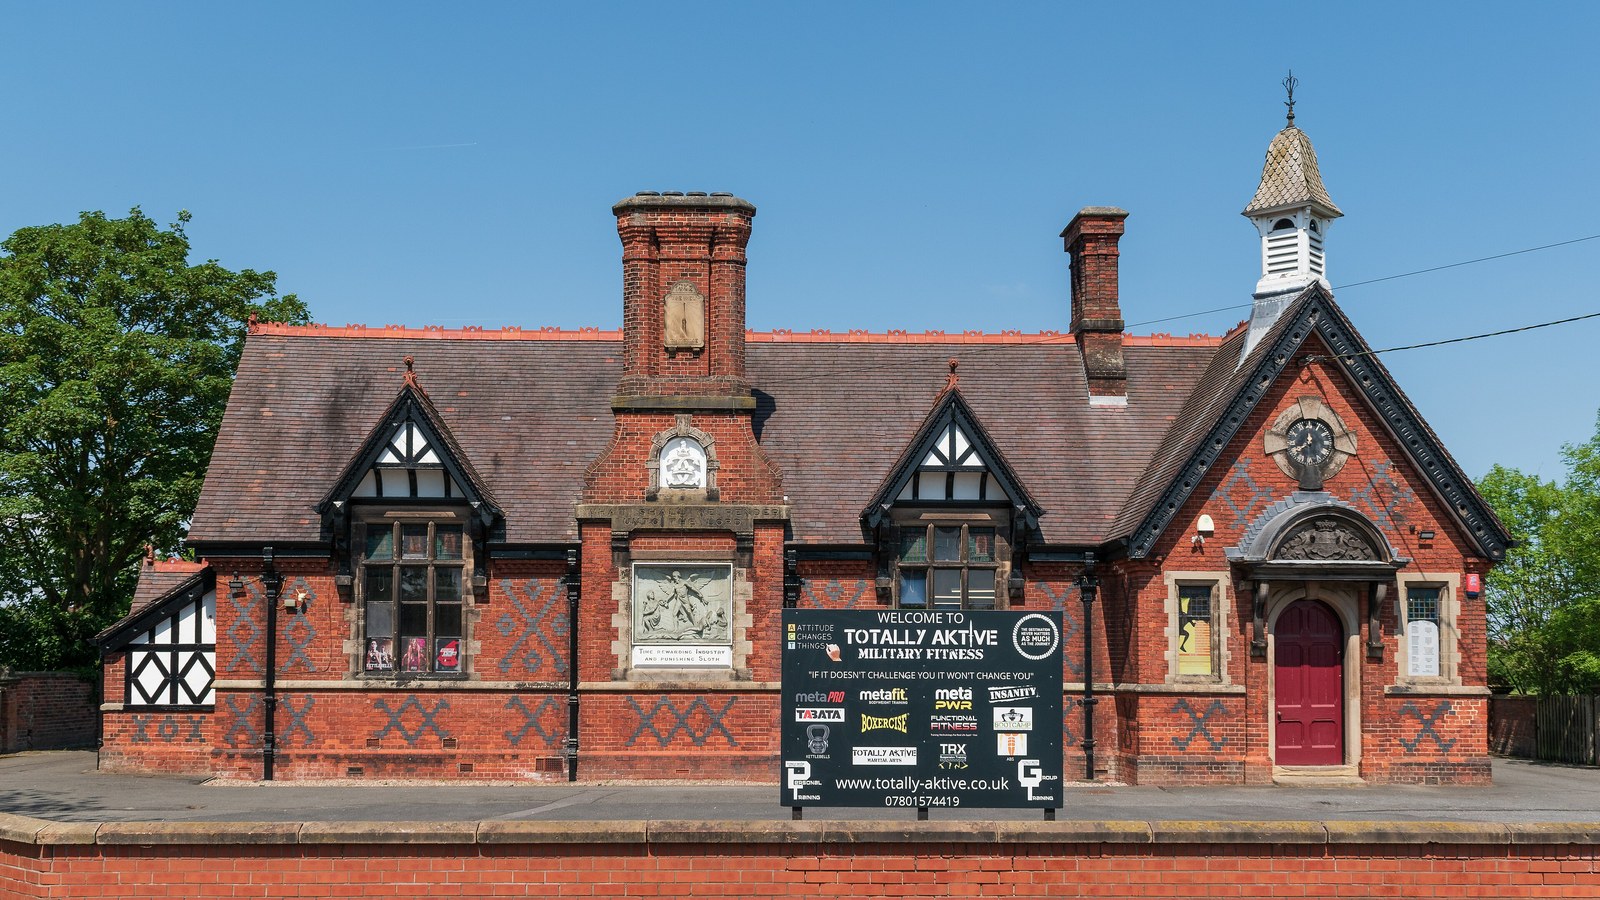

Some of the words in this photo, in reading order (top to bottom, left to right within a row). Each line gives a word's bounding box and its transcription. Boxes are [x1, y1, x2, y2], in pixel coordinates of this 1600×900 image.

[877, 612, 943, 624] WELCOME
[946, 612, 964, 624] TO
[844, 628, 927, 645] TOTALLY
[931, 622, 998, 647] AKTIVE
[858, 648, 923, 660] MILITARY
[926, 648, 984, 660] FITNESS
[820, 671, 829, 679] IT
[830, 671, 866, 679] DOESN'T
[867, 671, 916, 679] CHALLENGE
[946, 672, 975, 680] WON'T
[976, 672, 1011, 680] CHANGE
[935, 687, 972, 700] meta
[989, 687, 1037, 700] INSANITY
[935, 701, 972, 710] PWR
[796, 709, 842, 719] TABATA
[861, 713, 907, 733] BOXERCISE
[931, 722, 978, 730] FITNESS
[940, 744, 967, 754] TRX
[835, 776, 1009, 793] www.totally-aktive.co.uk
[885, 796, 960, 807] 07801574419
